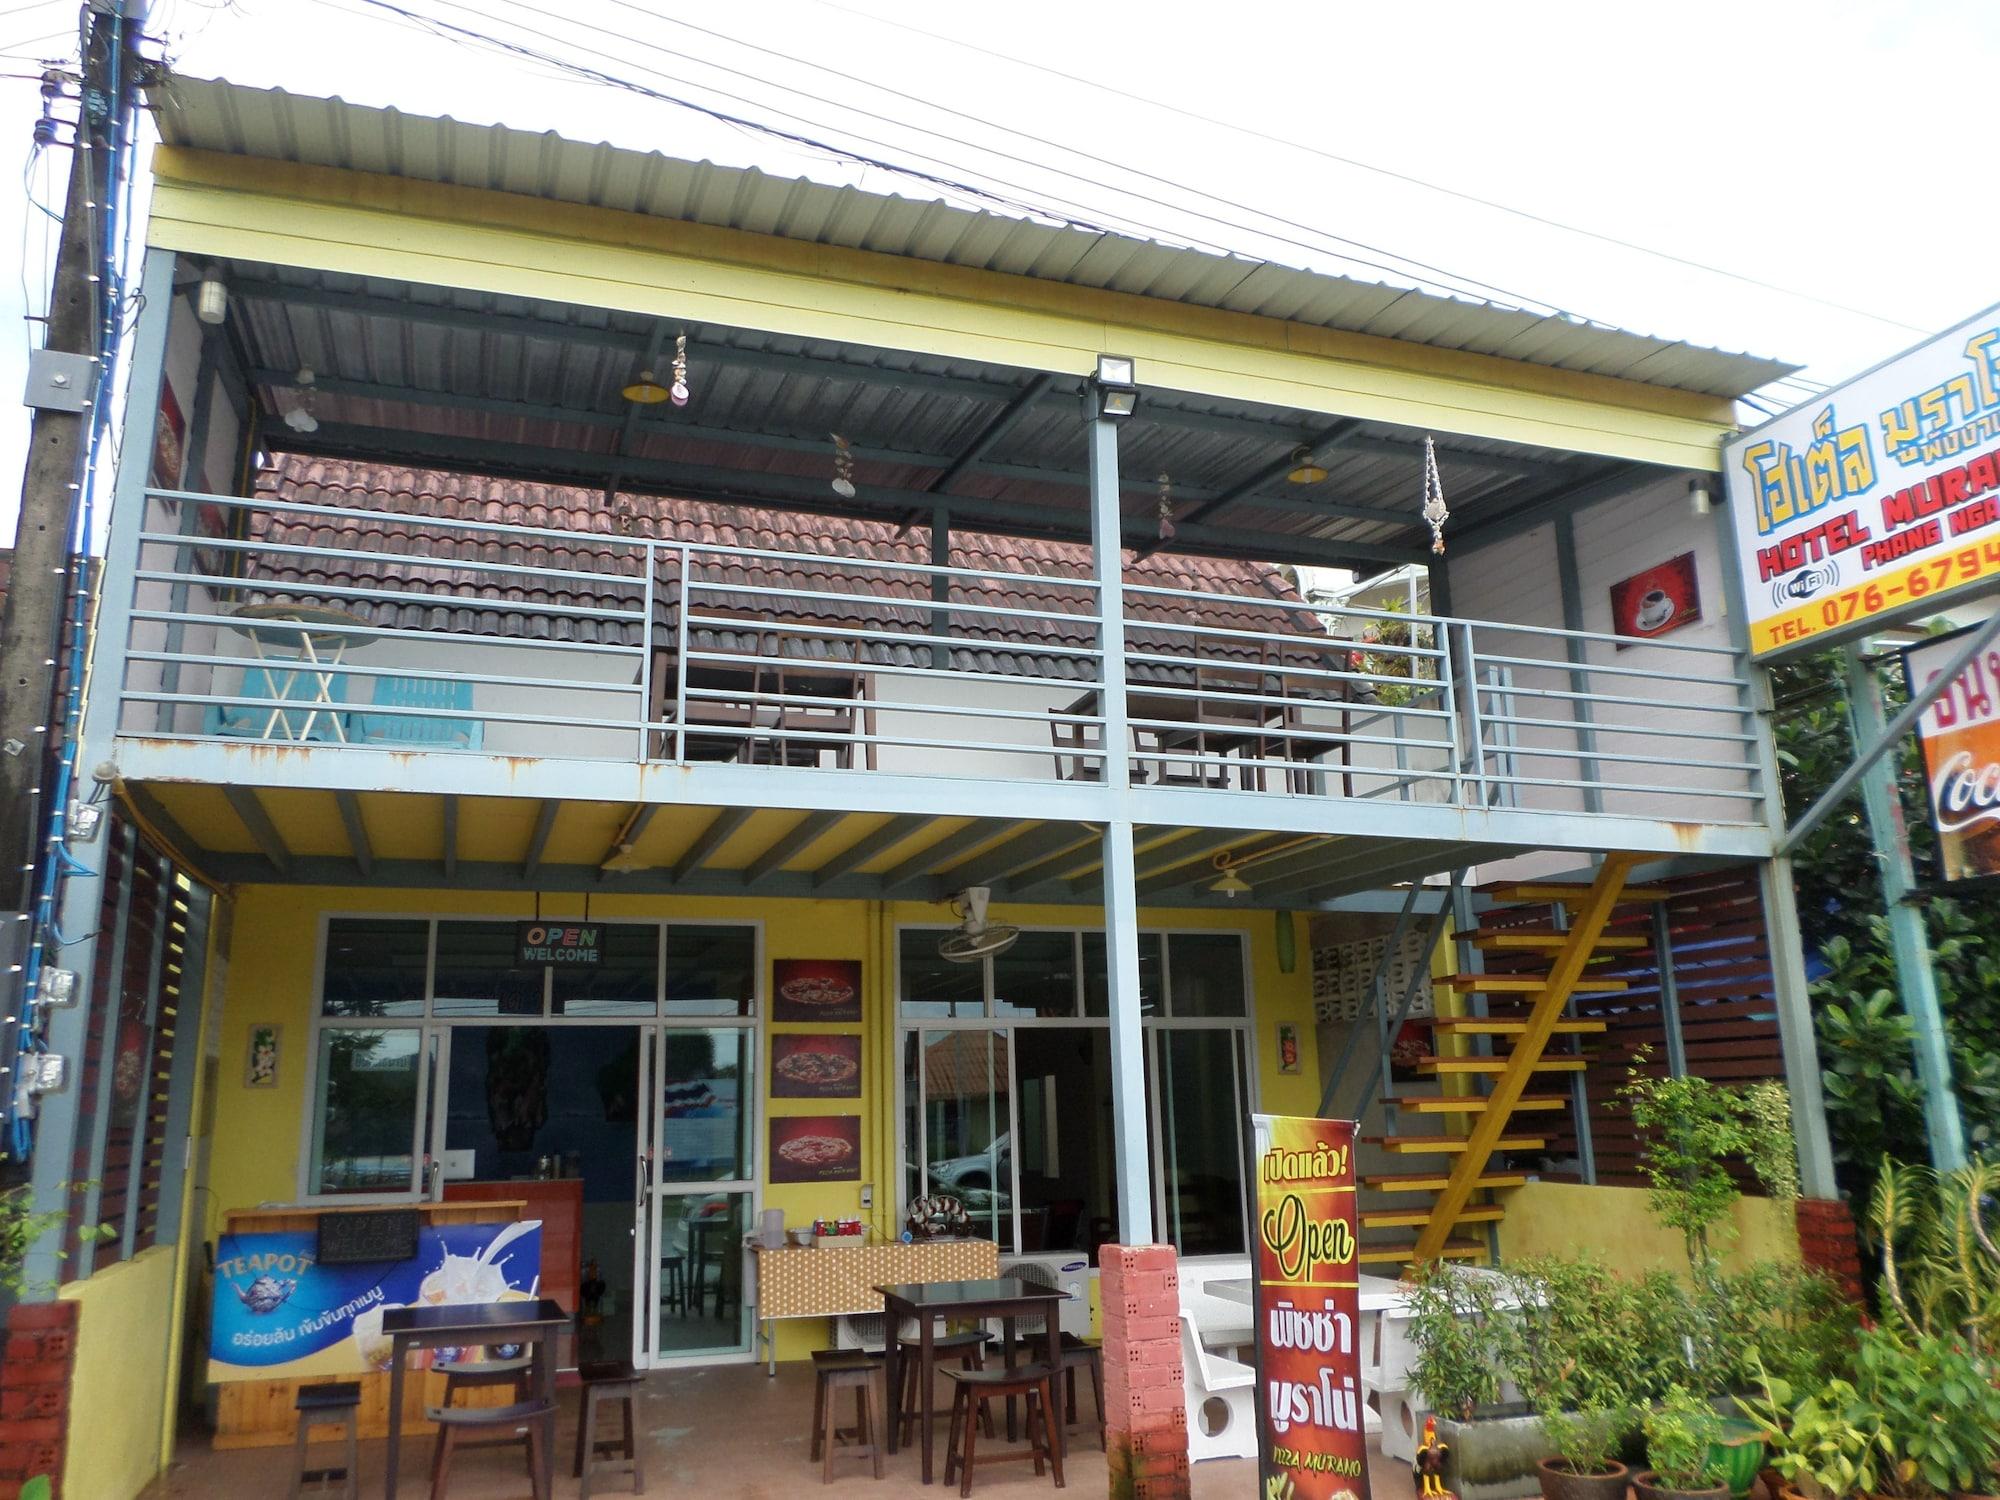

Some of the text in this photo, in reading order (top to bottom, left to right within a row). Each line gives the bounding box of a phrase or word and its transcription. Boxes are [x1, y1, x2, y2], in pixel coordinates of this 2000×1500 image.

[1757, 449, 2000, 583] HOTEL MURA
[1860, 494, 2000, 571] PHANG NGA
[1769, 617, 1816, 645] TEL.
[527, 927, 597, 946] OPEN
[523, 947, 598, 961] WELCOME
[1264, 1141, 1348, 1182] เปิดแล้ว!
[1262, 1193, 1356, 1282] Open
[216, 1253, 313, 1278] TEAPOT
[1270, 1368, 1358, 1433] มูราโน่
[1304, 1451, 1362, 1477] MURANO
